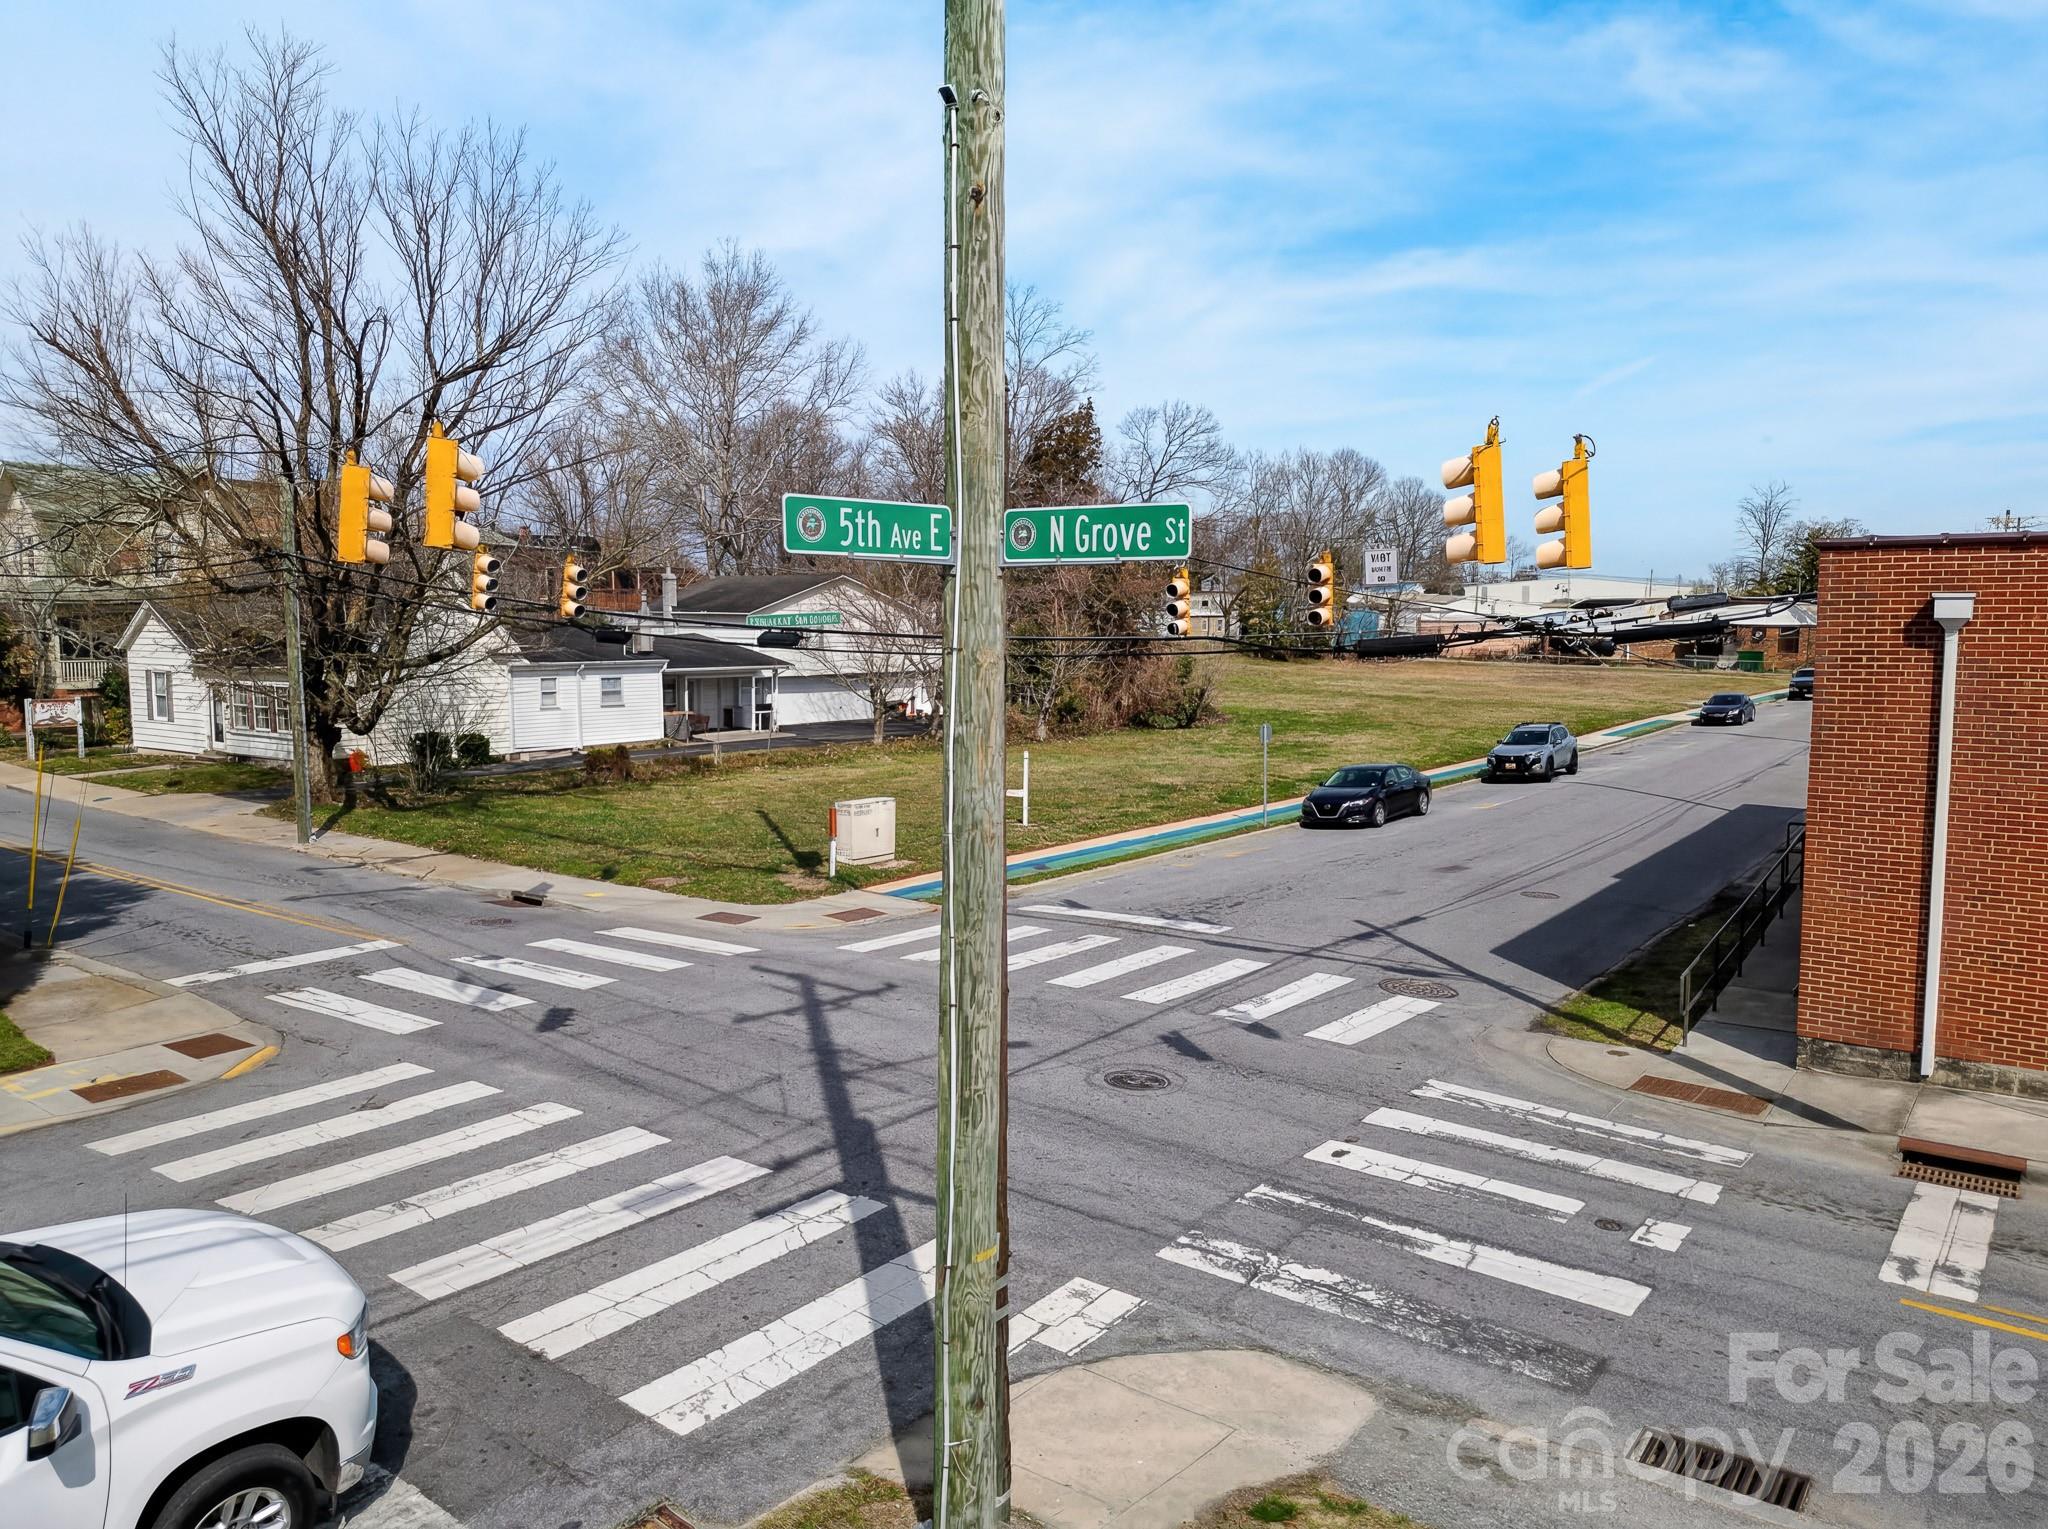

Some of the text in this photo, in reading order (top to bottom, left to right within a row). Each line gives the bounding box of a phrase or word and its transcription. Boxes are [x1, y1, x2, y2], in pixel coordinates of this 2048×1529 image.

[839, 507, 881, 548] 5th
[890, 522, 922, 550] Ave
[930, 513, 943, 551] E
[1050, 515, 1064, 553] N
[1075, 514, 1152, 553] Grove
[1165, 517, 1186, 544] St
